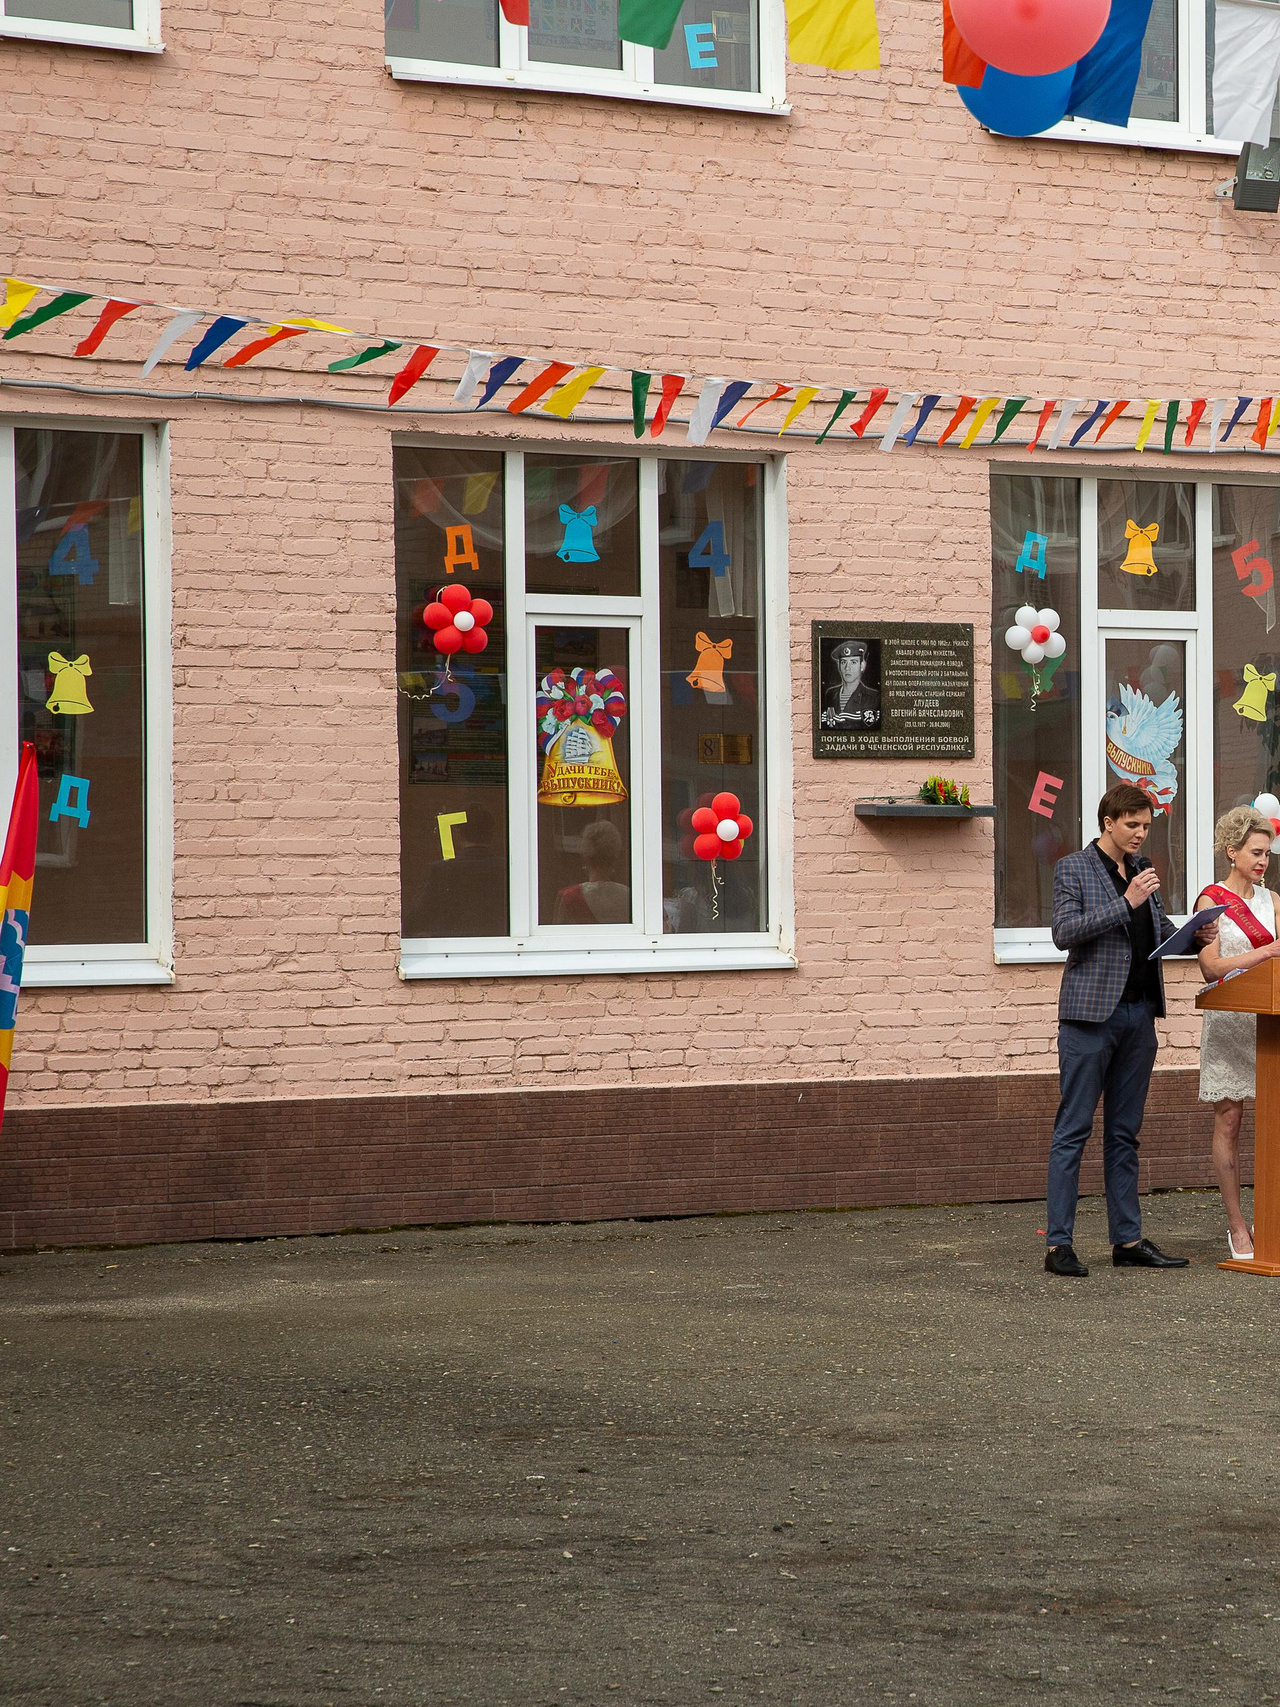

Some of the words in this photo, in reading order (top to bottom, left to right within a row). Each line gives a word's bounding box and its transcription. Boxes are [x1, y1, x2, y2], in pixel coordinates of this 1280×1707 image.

[683, 22, 718, 69] Е
[48, 524, 100, 585] 4
[443, 524, 480, 574] Д
[688, 520, 731, 578] 4
[1015, 530, 1048, 580] Д
[1230, 538, 1276, 598] 5
[891, 708, 917, 717] ЕВГЕНИЙ
[1106, 743, 1154, 775] ВЫПУСКНИК
[48, 773, 92, 829] Д
[540, 777, 622, 792] ВЫПУСКНИК!
[1027, 770, 1064, 819] Е
[436, 810, 468, 860] Г
